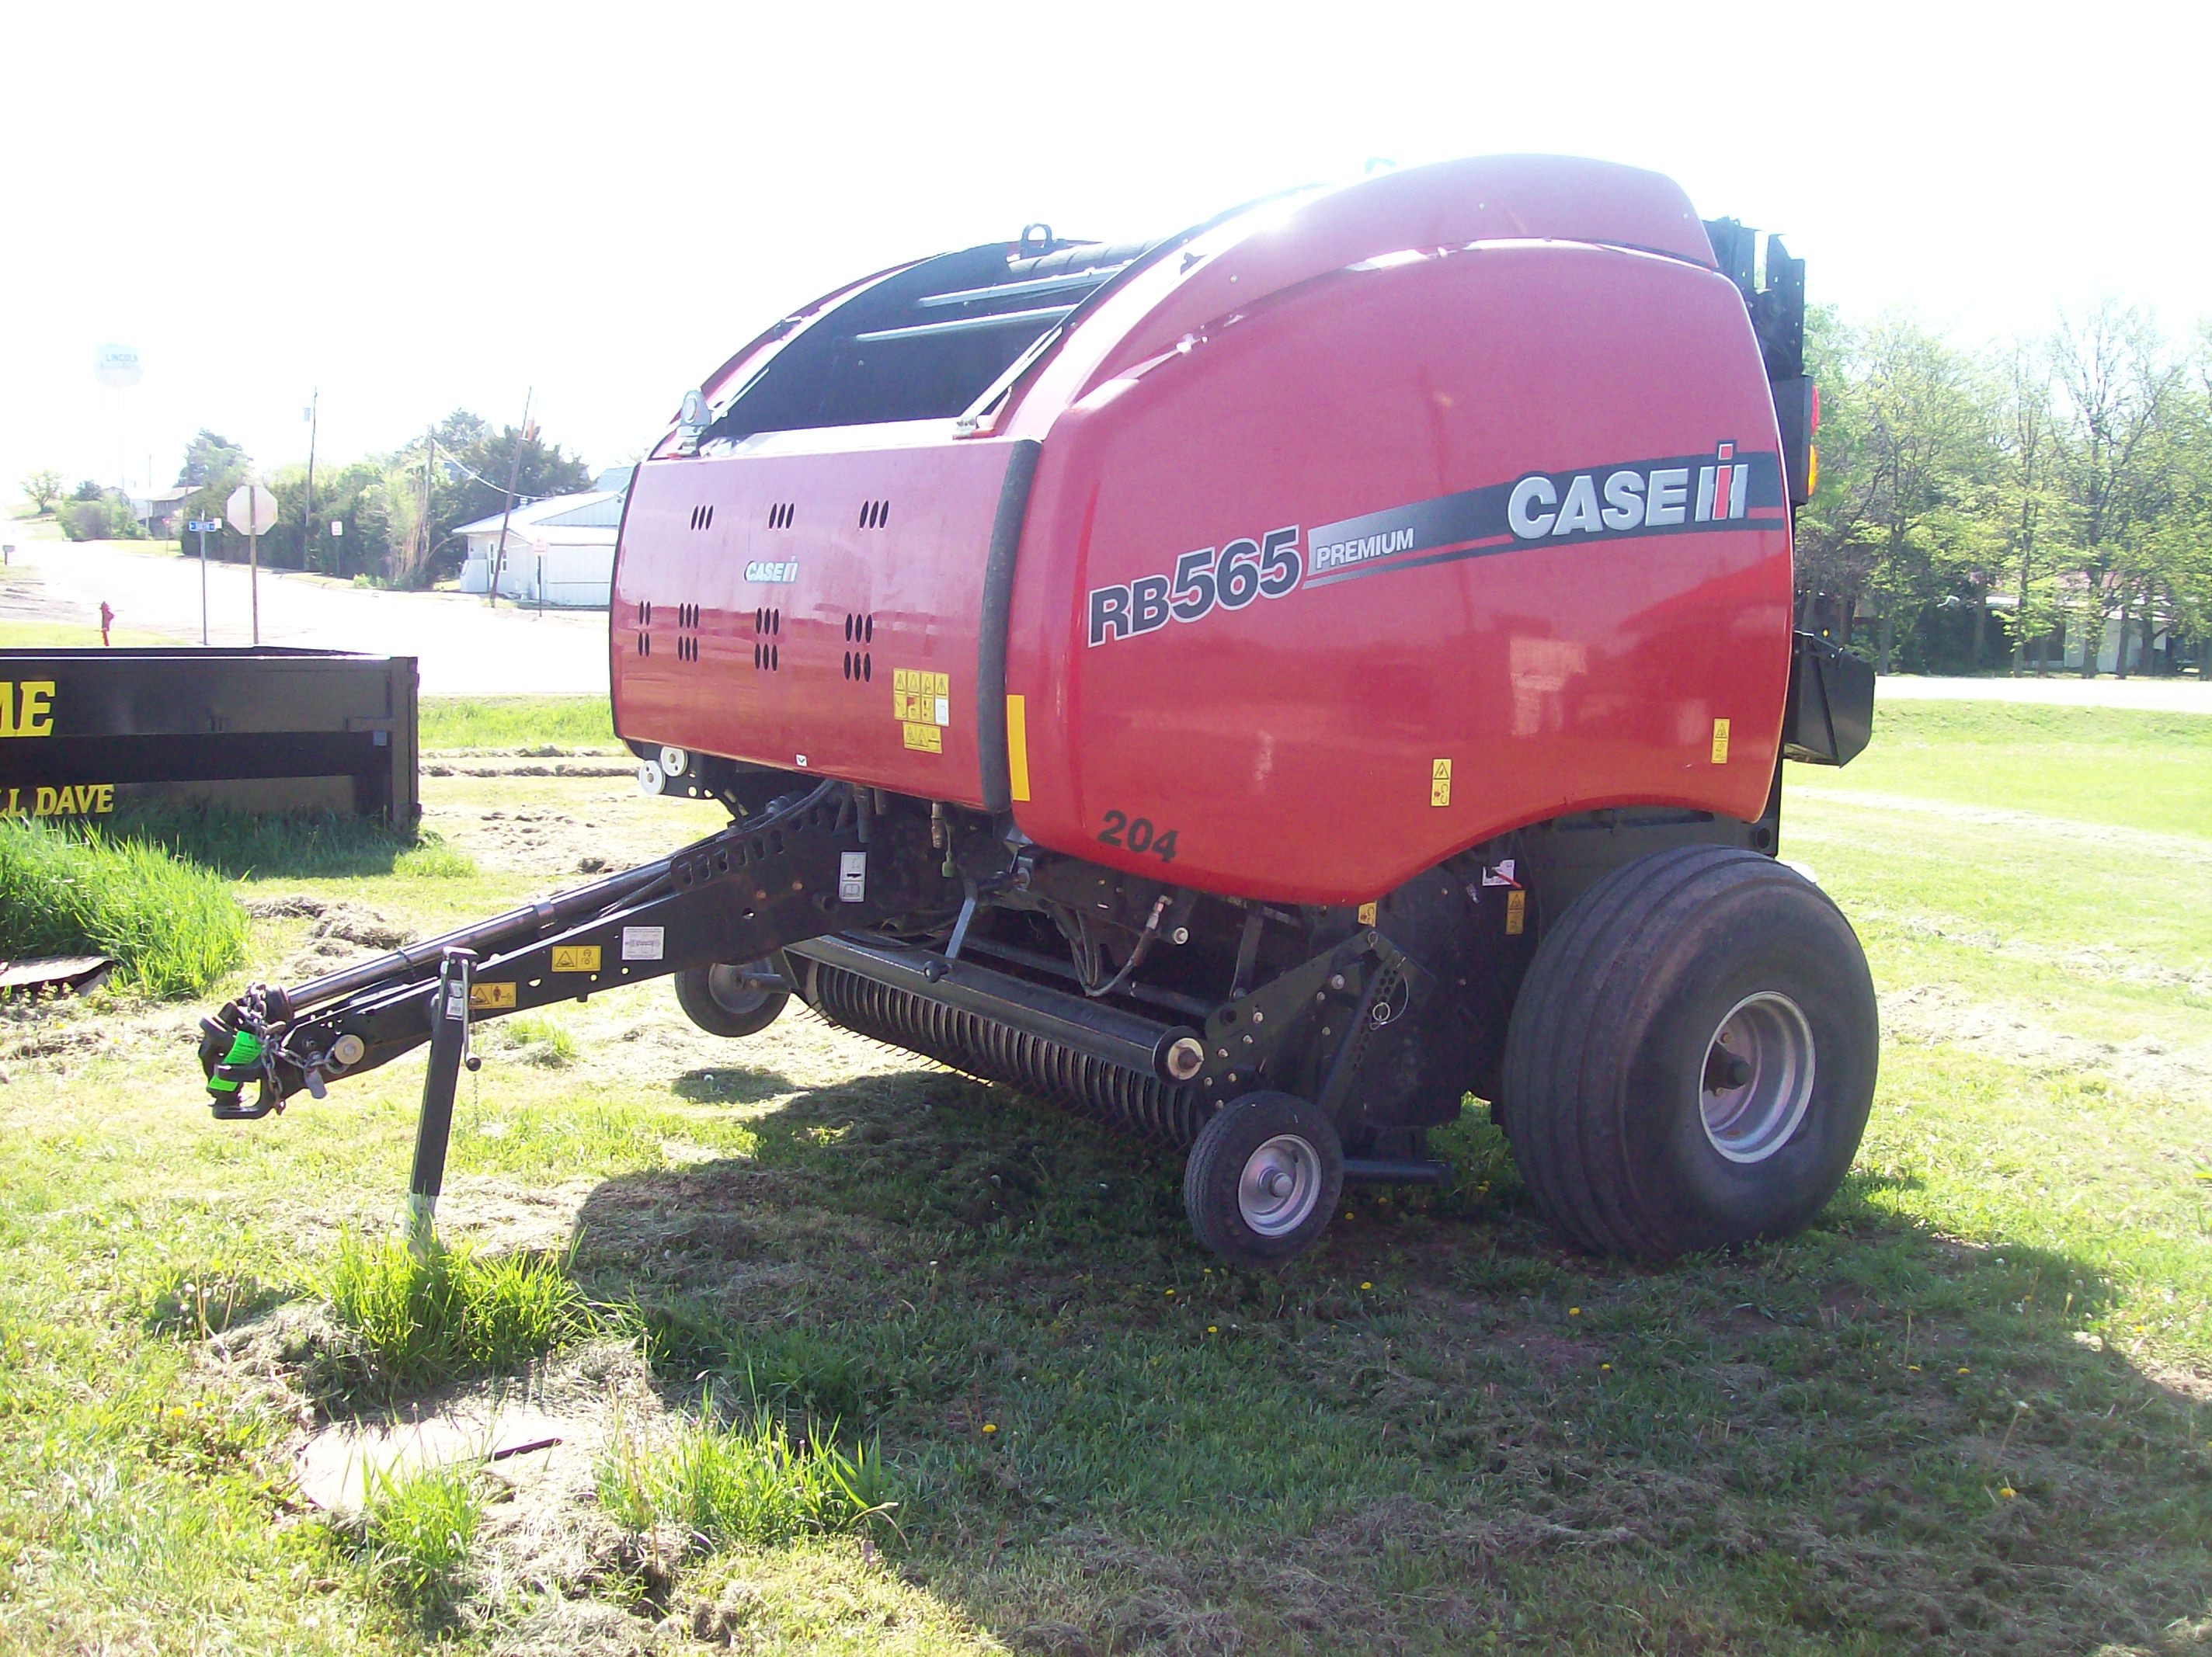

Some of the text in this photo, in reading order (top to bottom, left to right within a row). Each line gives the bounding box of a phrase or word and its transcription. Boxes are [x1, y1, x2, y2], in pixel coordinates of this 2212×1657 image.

[1508, 468, 1689, 539] CASE
[1087, 524, 1414, 648] RB565 PREMIUM
[0, 783, 114, 817] L DAVE
[1097, 809, 1179, 863] 204
